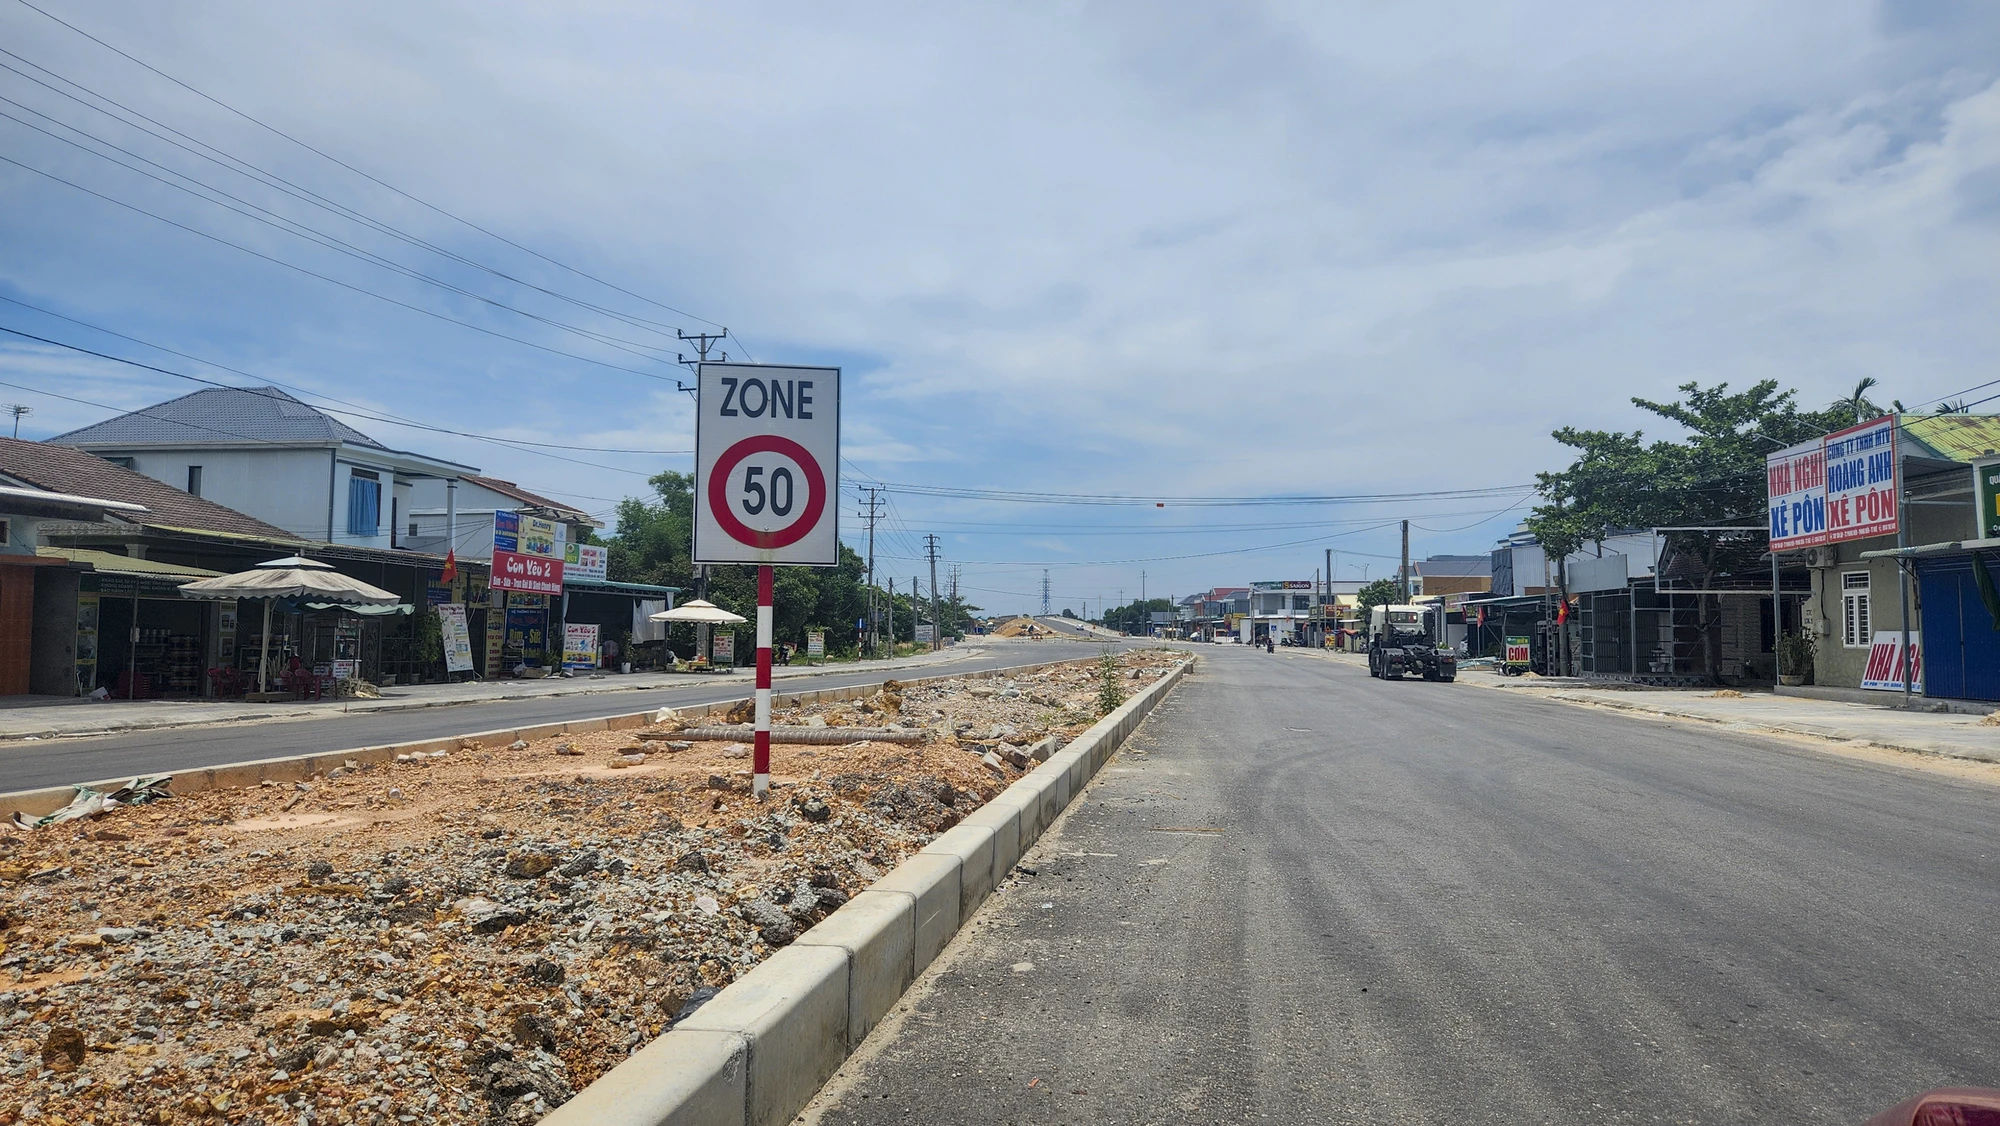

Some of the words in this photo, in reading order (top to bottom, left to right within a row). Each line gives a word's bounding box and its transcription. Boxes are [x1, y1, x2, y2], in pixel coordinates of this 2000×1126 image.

[720, 377, 813, 419] ZONE
[1828, 440, 1844, 460] CÔNG
[1847, 438, 1854, 455] TY
[1875, 426, 1890, 447] MTV
[742, 466, 793, 516] 50
[1769, 457, 1791, 498] NHÀ
[1828, 457, 1864, 493] HOÀNG
[1869, 450, 1892, 484] ANH
[1771, 500, 1788, 539] XÊ
[1793, 493, 1825, 535] PÔN
[1829, 493, 1850, 529] XÊ
[1855, 486, 1894, 524] PÔN
[507, 557, 524, 574] Con
[526, 559, 542, 576] Yêu
[544, 562, 551, 577] 2
[568, 625, 578, 633] Con
[1508, 645, 1528, 661] CƠM
